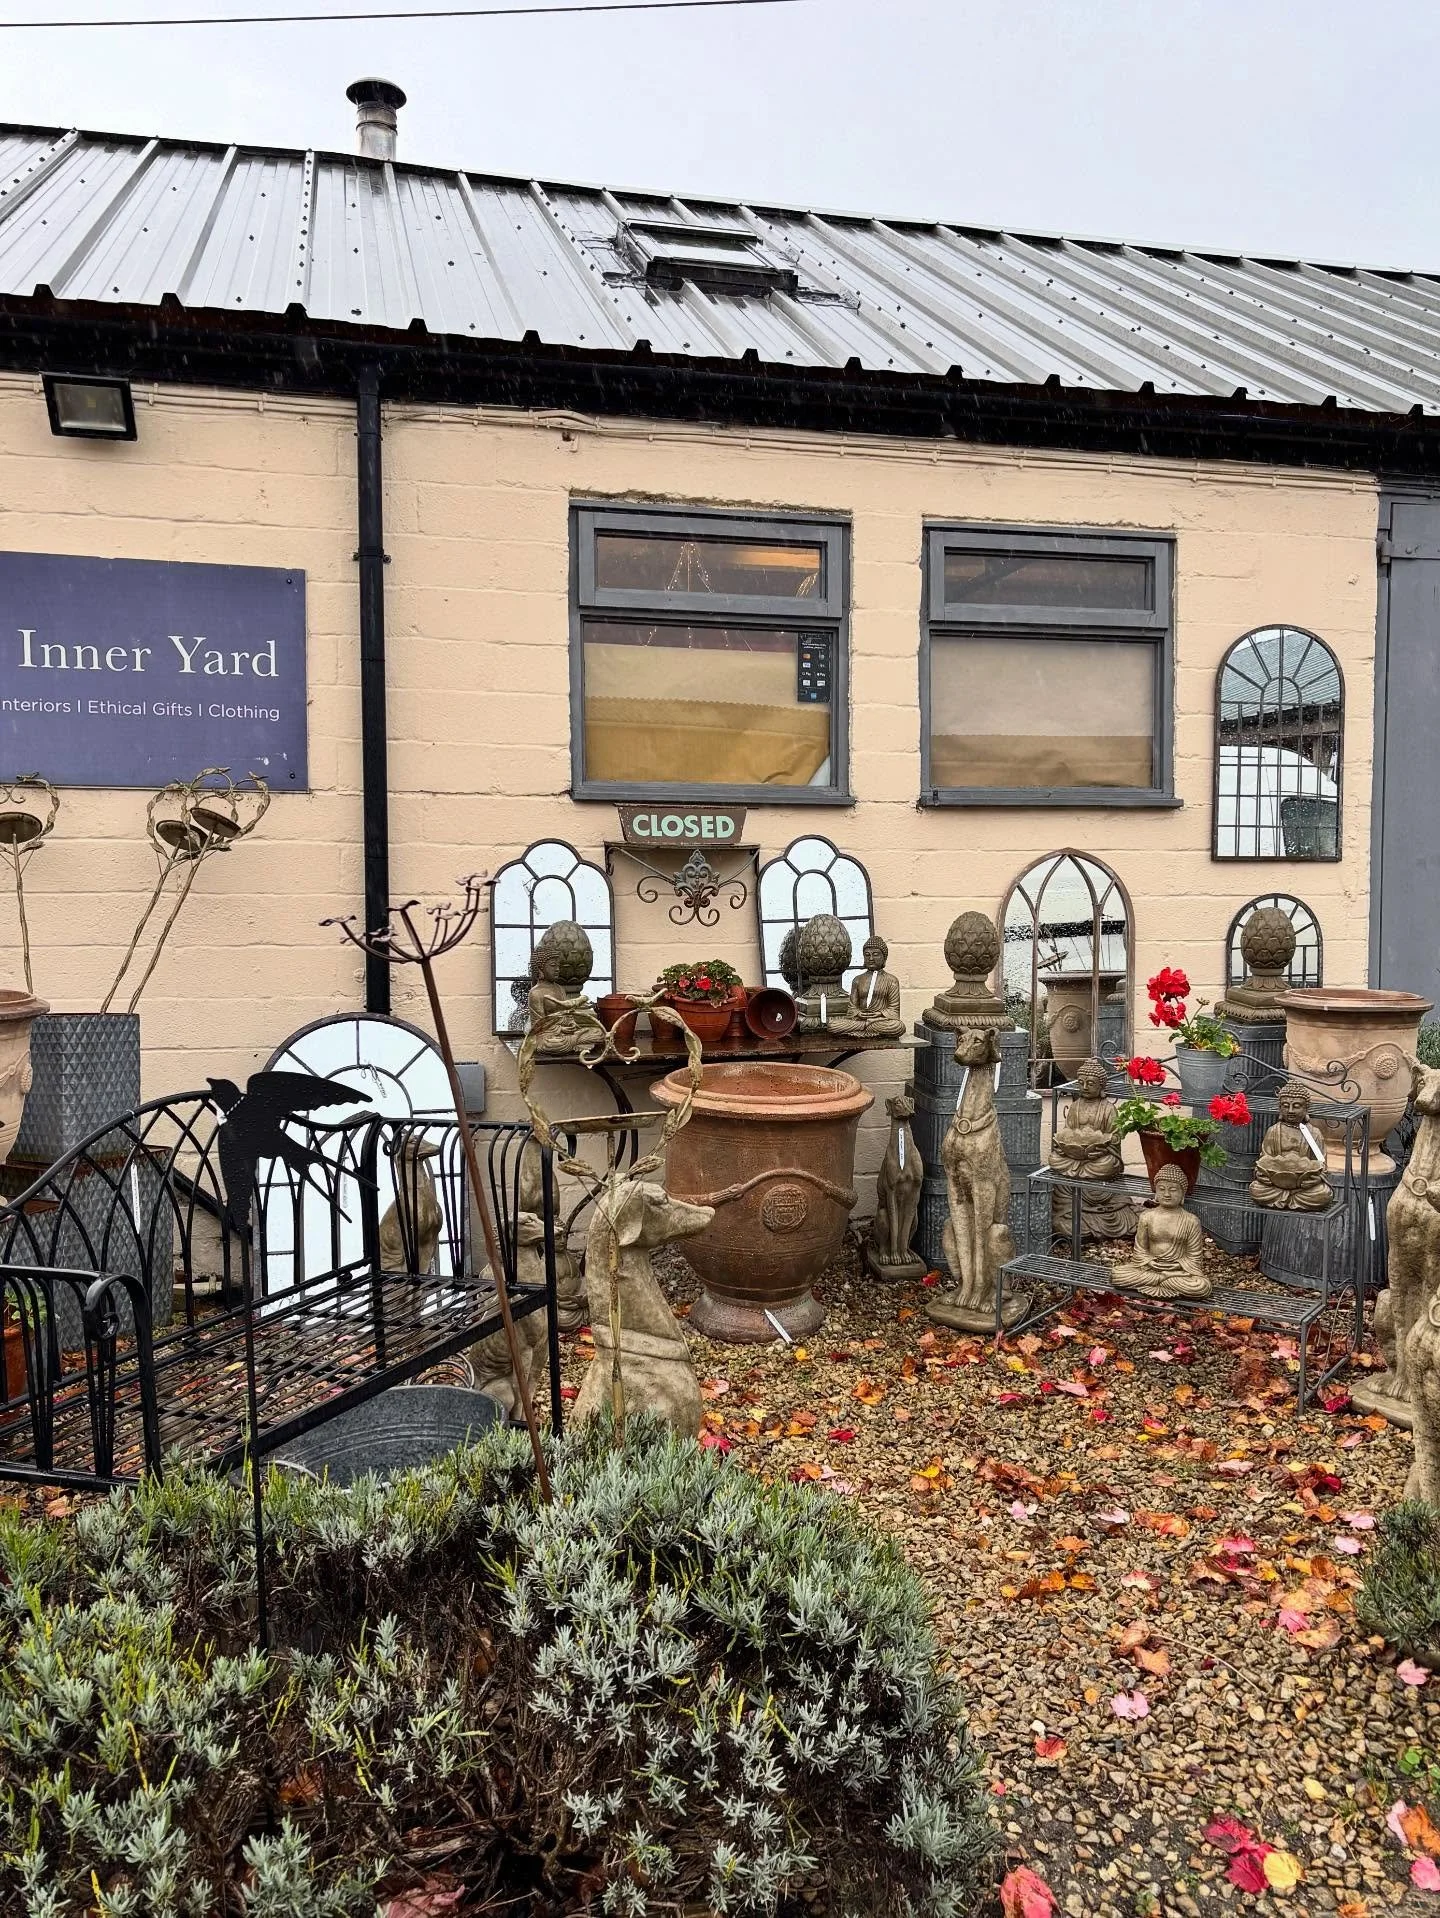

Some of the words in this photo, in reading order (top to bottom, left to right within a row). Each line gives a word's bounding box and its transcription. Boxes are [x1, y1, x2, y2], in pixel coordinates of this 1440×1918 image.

[18, 629, 152, 672] Inner
[168, 635, 280, 677] Yard
[1, 697, 71, 713] nteriors
[88, 700, 146, 715] Ethical
[152, 702, 193, 717] Gifts
[208, 703, 280, 722] Clothing
[632, 814, 735, 839] CLOSED
